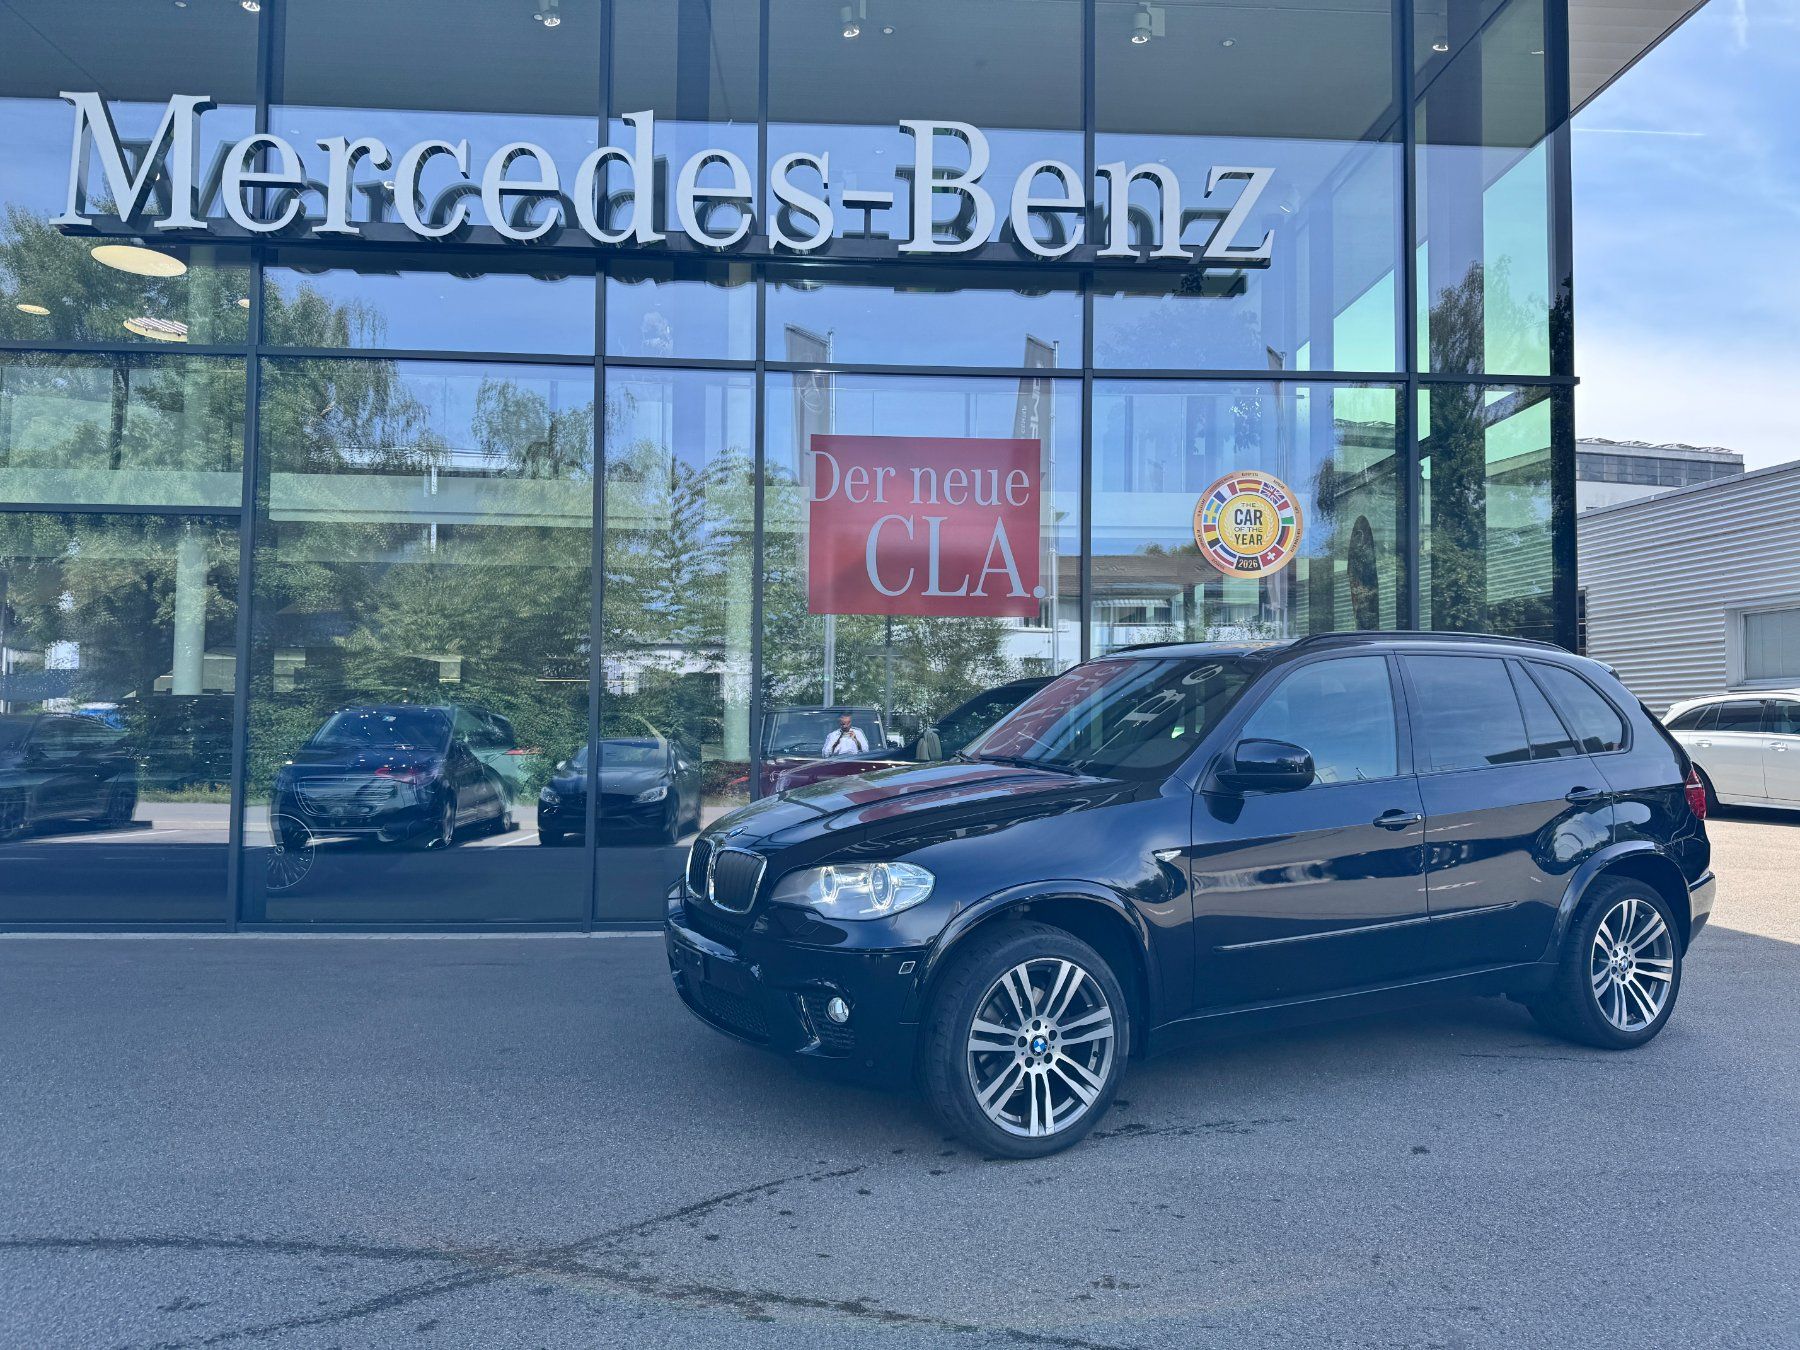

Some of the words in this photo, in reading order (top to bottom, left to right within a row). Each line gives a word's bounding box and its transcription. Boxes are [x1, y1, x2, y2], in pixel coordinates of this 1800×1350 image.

[50, 91, 1275, 261] Mercedes-Benz
[809, 450, 895, 505] Der
[909, 467, 1030, 507] neue
[1234, 508, 1263, 526] CAR
[865, 514, 1046, 599] CLA.
[1234, 533, 1263, 546] YEAR
[1238, 559, 1258, 569] 2026
